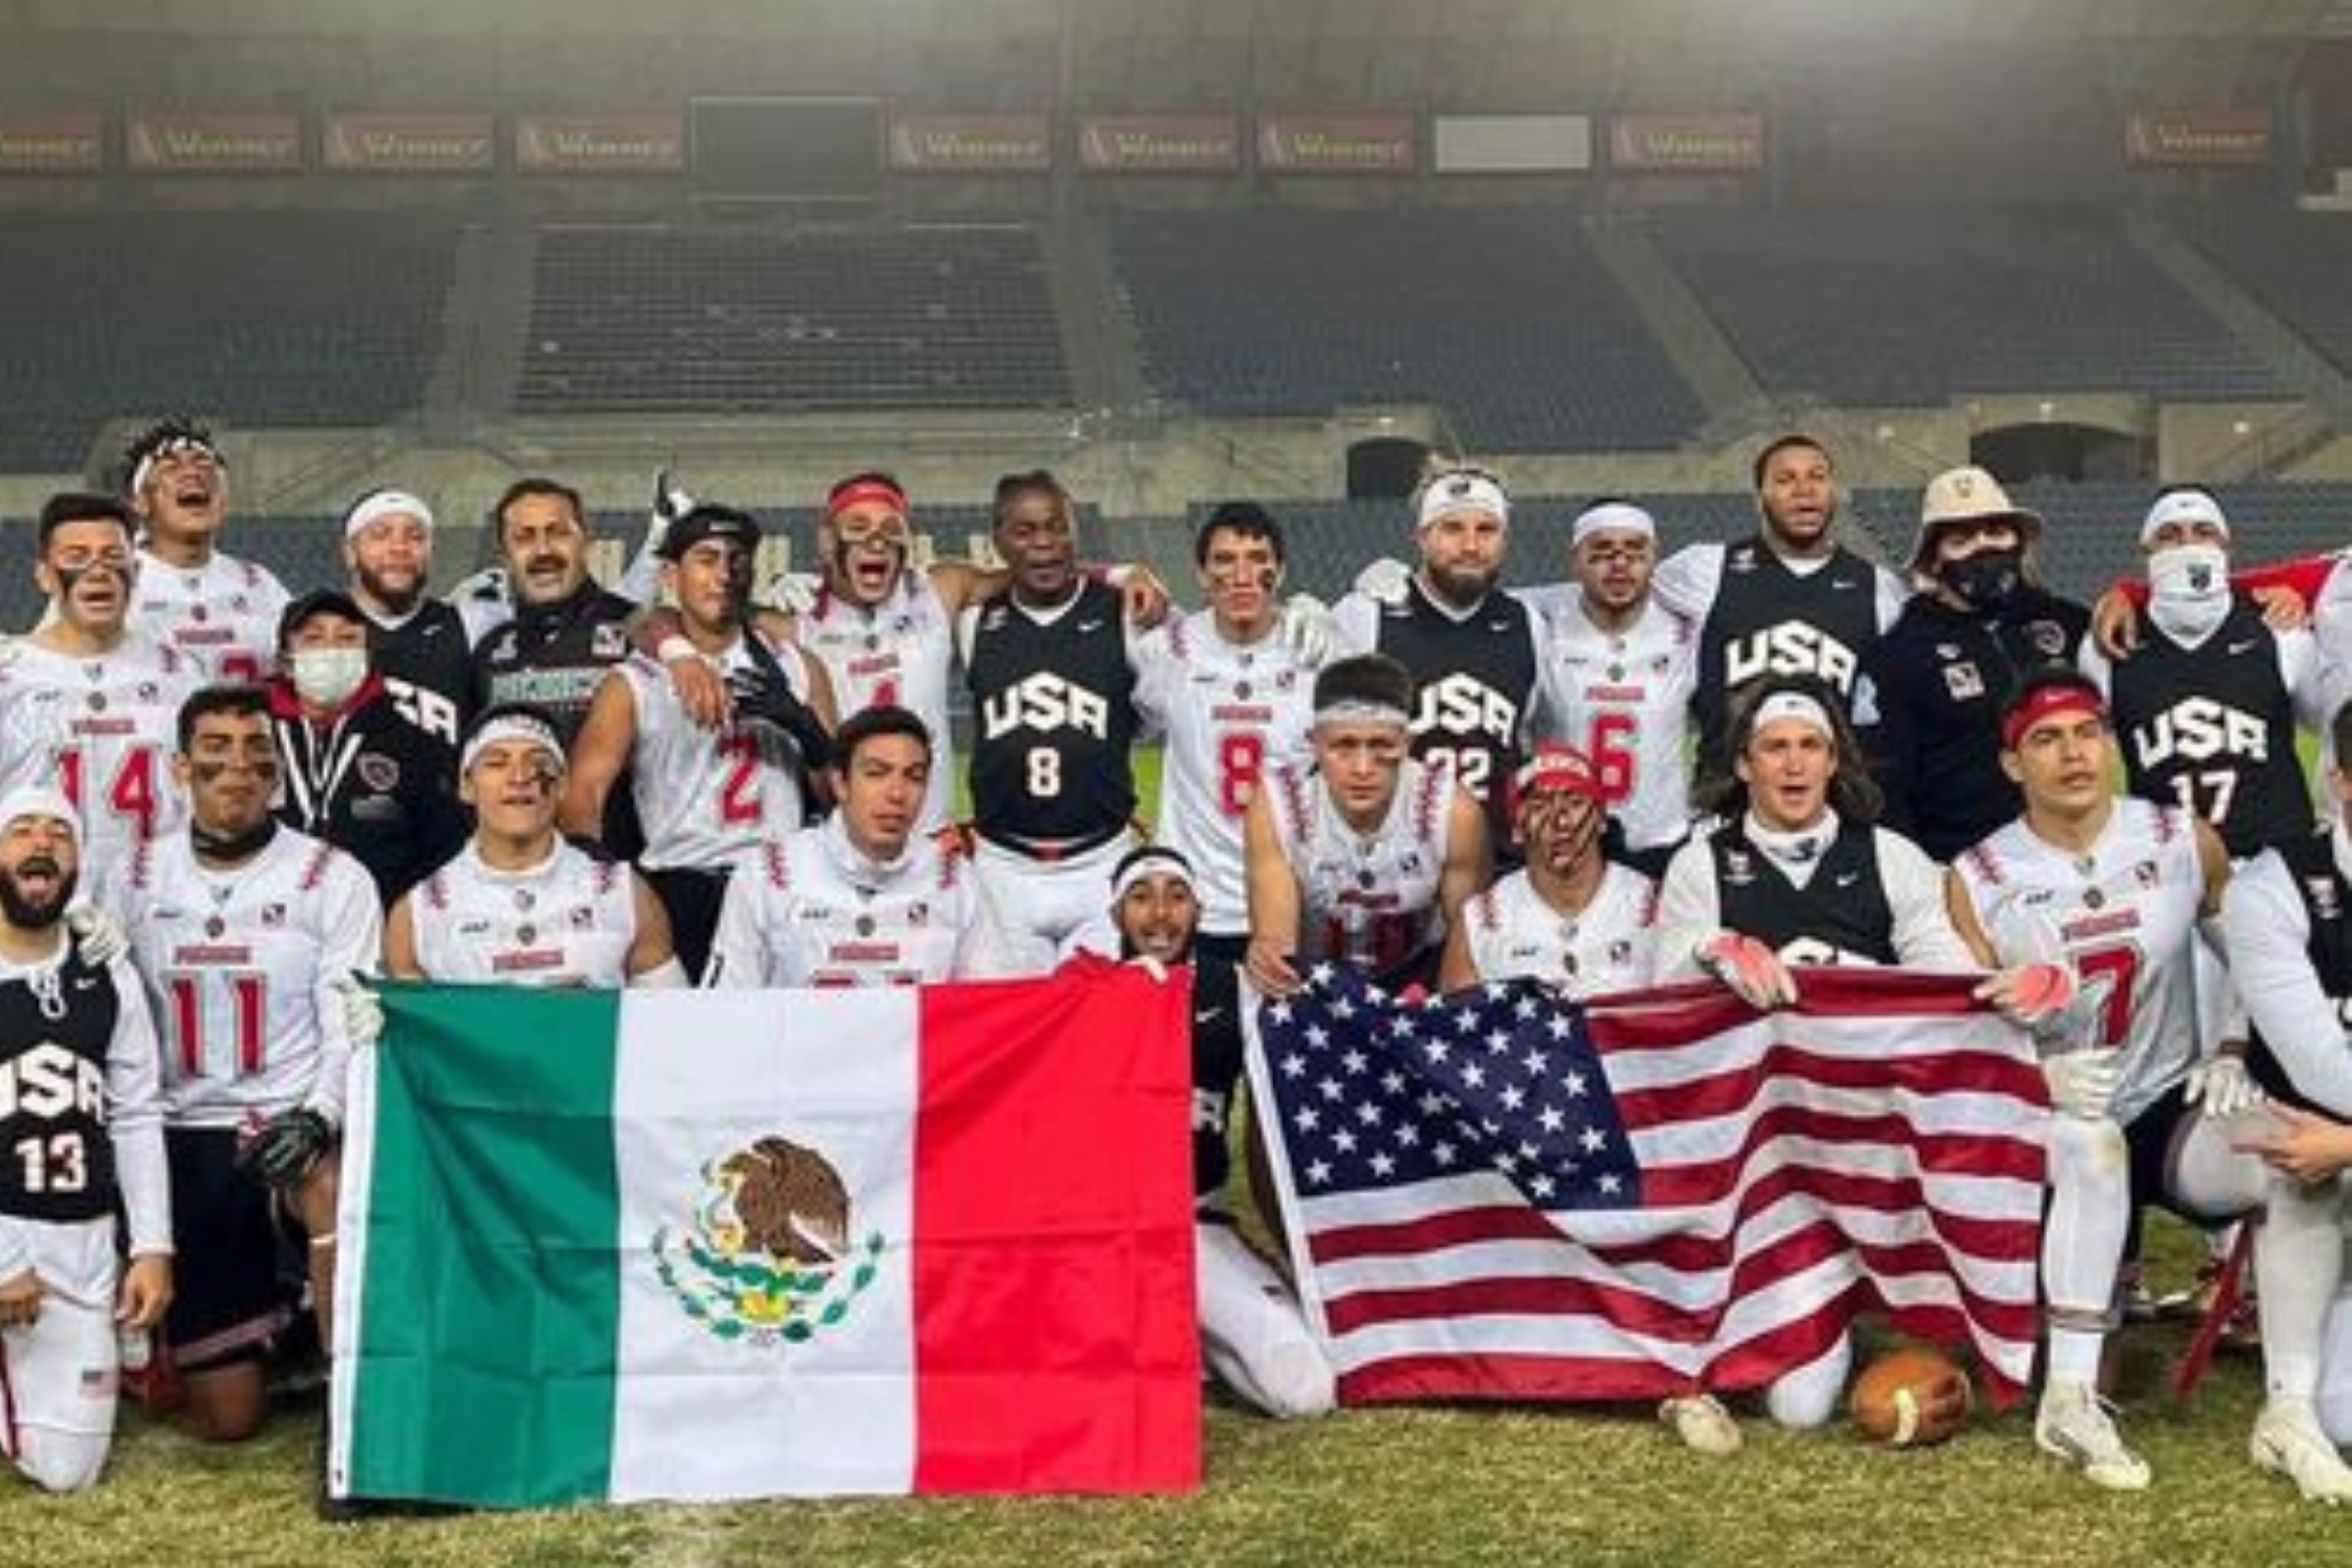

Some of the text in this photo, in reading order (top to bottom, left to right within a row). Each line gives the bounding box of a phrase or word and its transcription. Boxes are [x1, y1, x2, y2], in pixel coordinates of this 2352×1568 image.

[1728, 619, 1858, 697] USA
[983, 671, 1107, 739] USA
[2133, 696, 2268, 770] USA
[52, 745, 161, 843] 14
[716, 735, 762, 824] 2
[1028, 747, 1061, 798] 8
[1218, 732, 1263, 817] 8
[1589, 710, 1637, 804] 6
[2170, 768, 2237, 825] 17
[161, 970, 267, 1079] 11
[2072, 942, 2142, 1049] 7
[15, 1132, 87, 1193] 13
